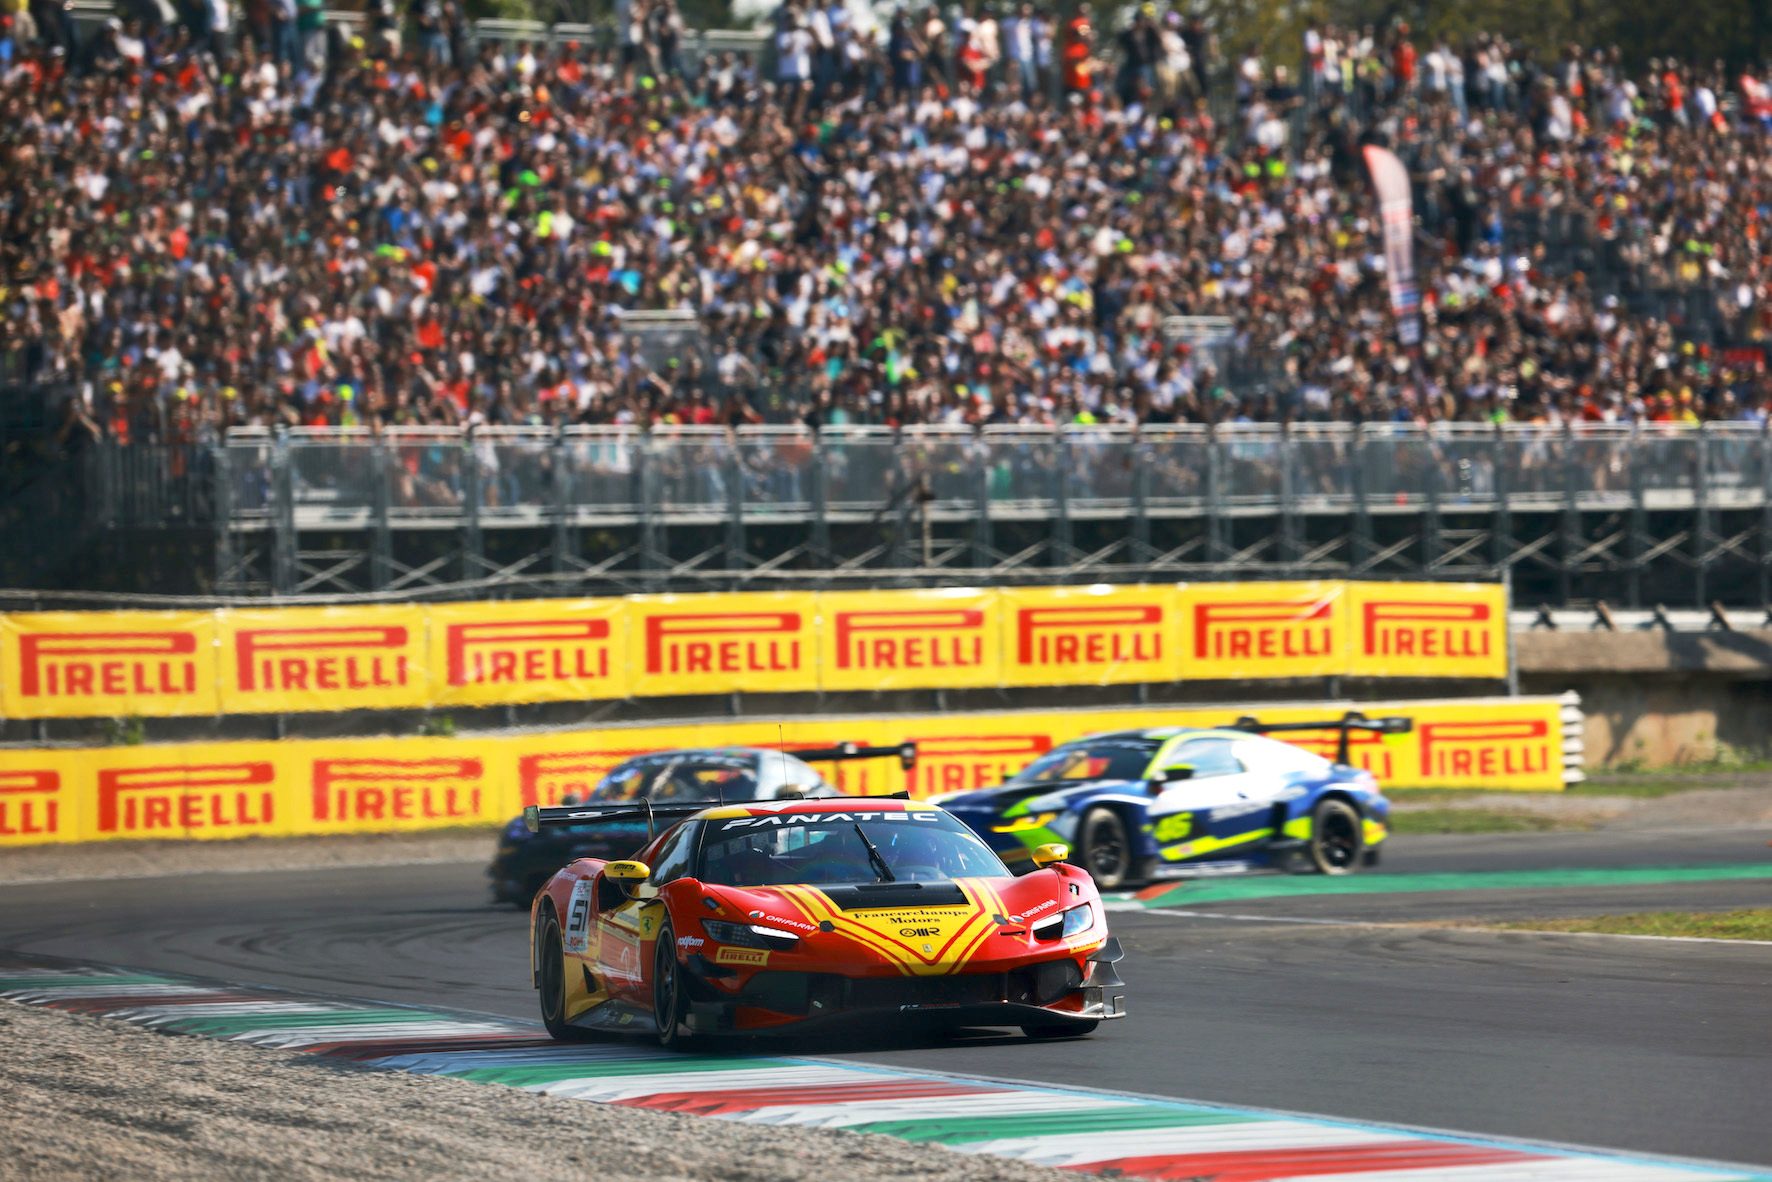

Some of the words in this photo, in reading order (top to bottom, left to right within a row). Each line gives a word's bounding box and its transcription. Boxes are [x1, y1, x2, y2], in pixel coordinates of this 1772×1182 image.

[447, 619, 610, 686] PIRELLI
[645, 613, 801, 674] PIRELLI
[836, 610, 984, 669] PIRELLI
[1018, 605, 1162, 665] PIRELLI
[1194, 601, 1331, 659] PIRELLI
[1363, 602, 1490, 656] PIRELLI
[19, 632, 196, 697] PIRELLI
[236, 626, 408, 691] PIRELLI
[1420, 720, 1548, 776] PIRELLI
[97, 762, 275, 832] PIRELLI
[313, 759, 483, 820] PIRELLI
[721, 812, 938, 831] FANATEC
[569, 899, 588, 932] 51
[765, 914, 816, 931] ORIFARM
[853, 909, 969, 919] Francorchamps
[889, 917, 941, 925] Motors
[1020, 898, 1058, 918] ORIFARM
[720, 948, 764, 963] PIRELLI
